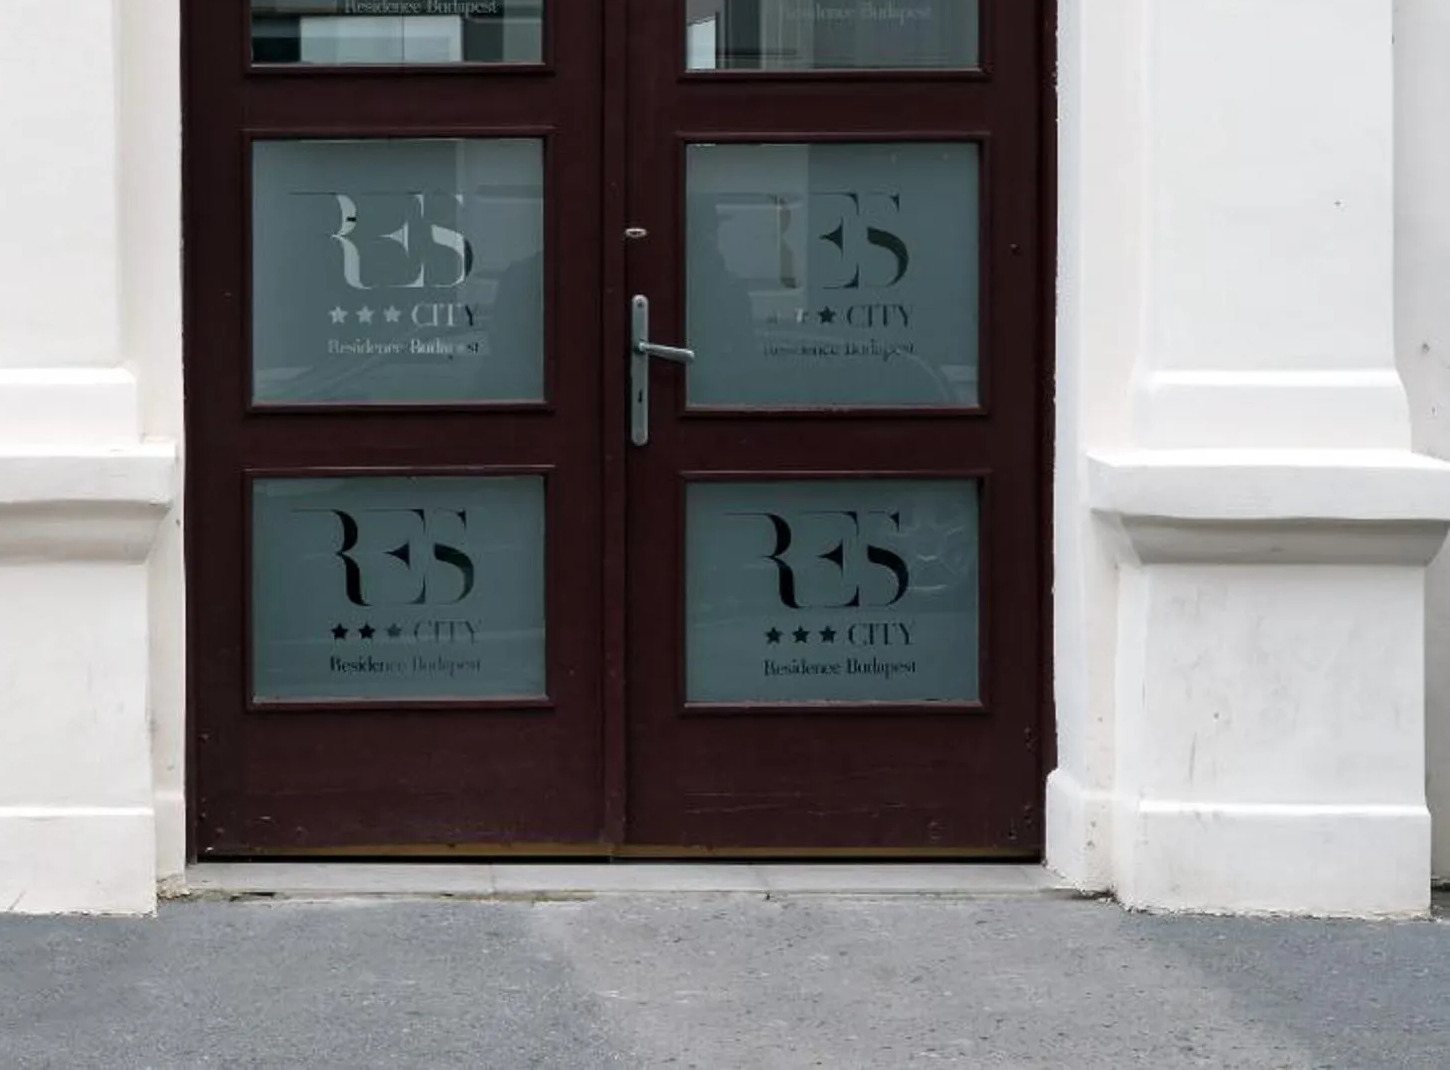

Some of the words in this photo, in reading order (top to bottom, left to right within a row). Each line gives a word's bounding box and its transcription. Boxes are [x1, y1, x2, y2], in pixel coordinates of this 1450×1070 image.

[411, 302, 480, 327] CITY
[846, 303, 913, 328] CITY
[410, 337, 480, 361] Budapst
[723, 509, 910, 610] RES
[413, 619, 480, 644] CITY
[847, 622, 915, 646] CITY
[764, 659, 841, 677] Residence
[846, 657, 917, 680] Budapest
